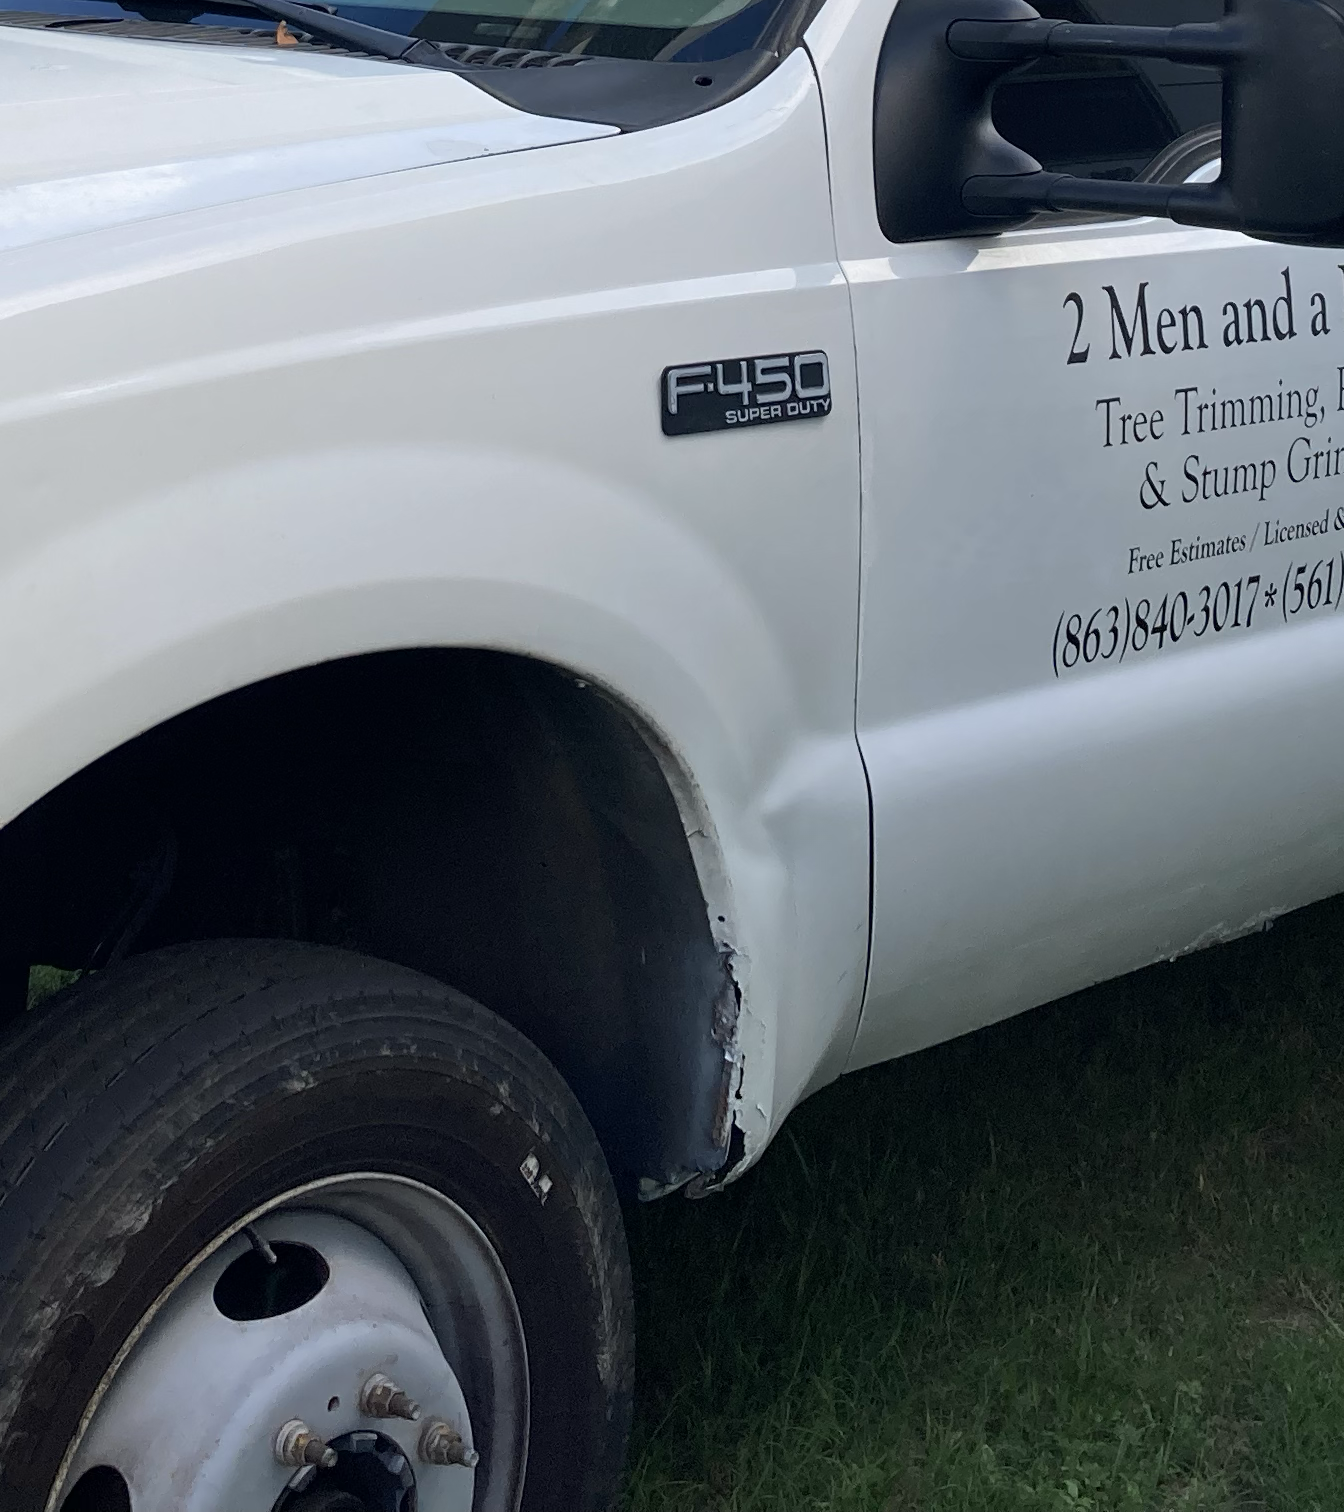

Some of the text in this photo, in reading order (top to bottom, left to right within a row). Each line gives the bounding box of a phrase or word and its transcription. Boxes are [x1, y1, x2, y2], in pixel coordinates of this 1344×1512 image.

[1062, 291, 1091, 365] 2
[1101, 281, 1209, 360] Men
[1222, 265, 1298, 348] and
[1310, 292, 1331, 337] a
[725, 397, 831, 424] SUPER DUTY
[1094, 396, 1165, 448] Tree
[1173, 378, 1325, 436] Trimming,
[1139, 461, 1171, 510] &
[1181, 454, 1276, 503] Stump
[1127, 546, 1165, 575] Free
[1169, 534, 1247, 566] Estimates
[1249, 521, 1261, 553] /
[1263, 508, 1330, 546] Licensed
